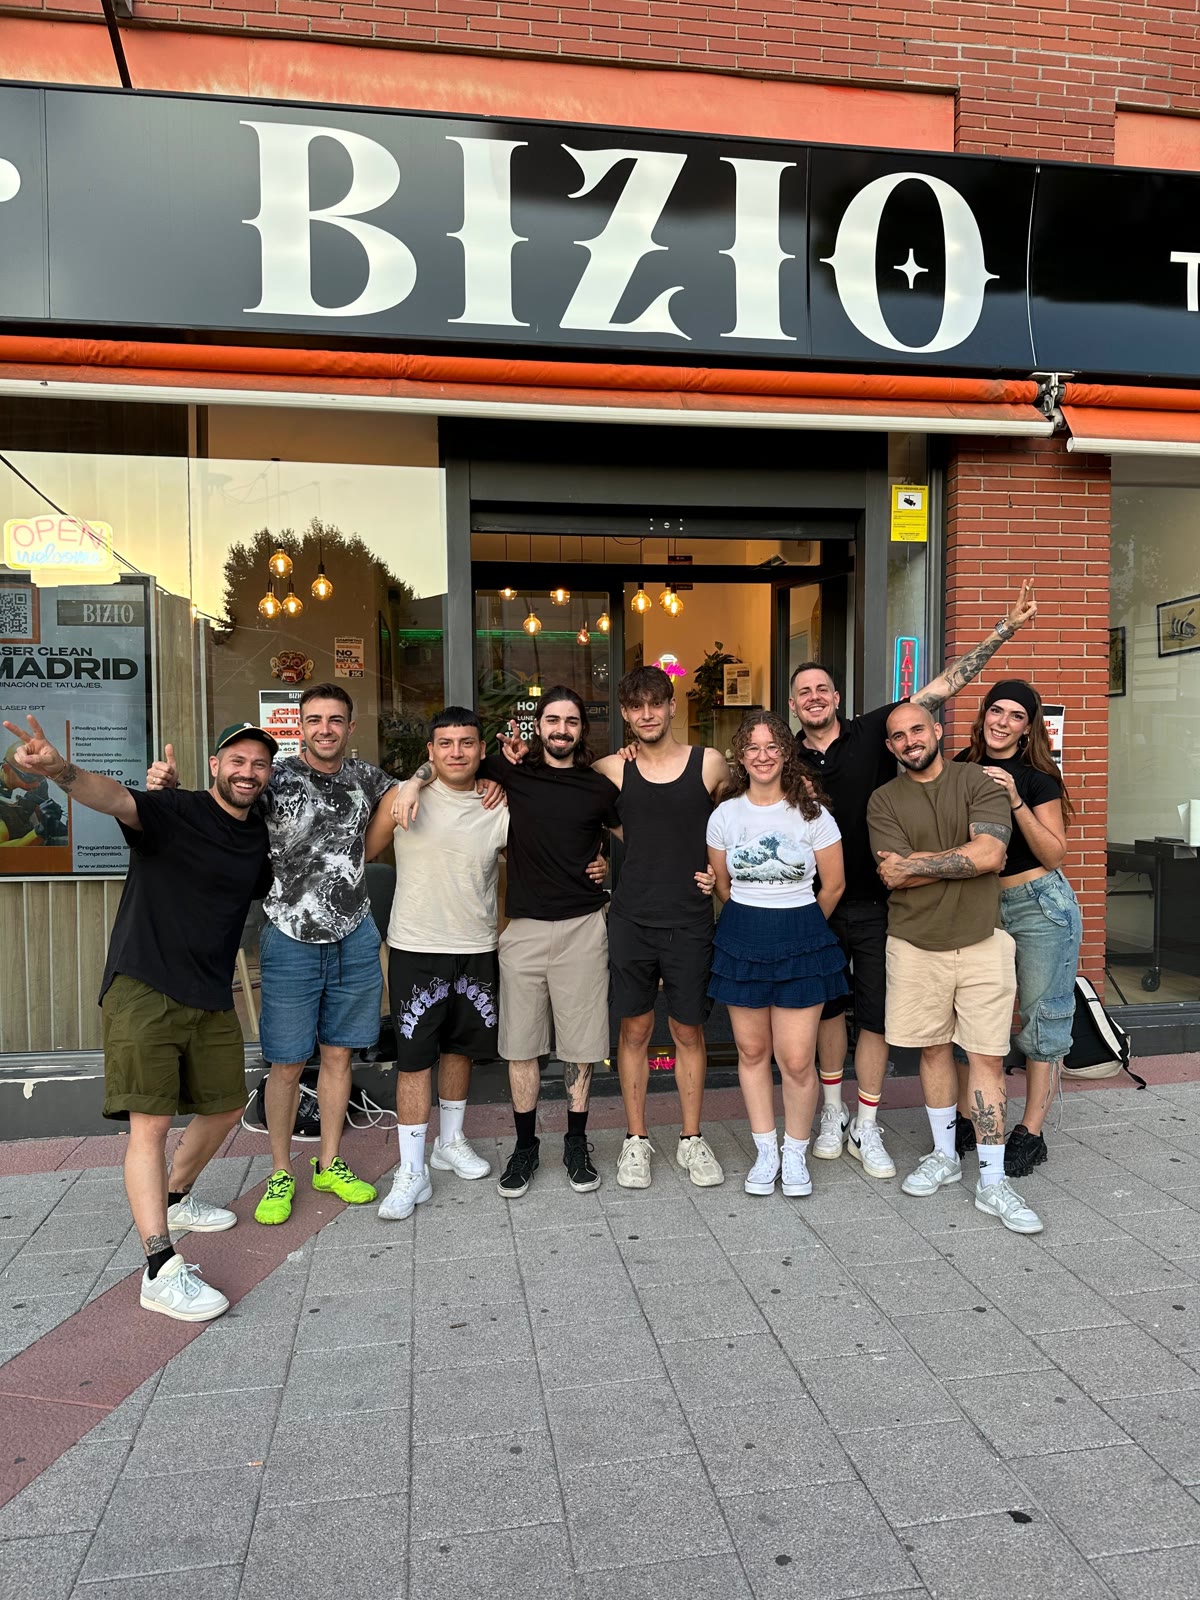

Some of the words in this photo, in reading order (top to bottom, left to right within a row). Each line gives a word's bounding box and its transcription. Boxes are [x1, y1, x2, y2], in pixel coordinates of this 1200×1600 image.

[239, 120, 1000, 354] BIZIO
[13, 519, 104, 549] OPEN
[82, 603, 134, 624] BIZIO
[0, 647, 34, 656] SER
[37, 647, 92, 656] CLEAN
[901, 641, 914, 700] TATT
